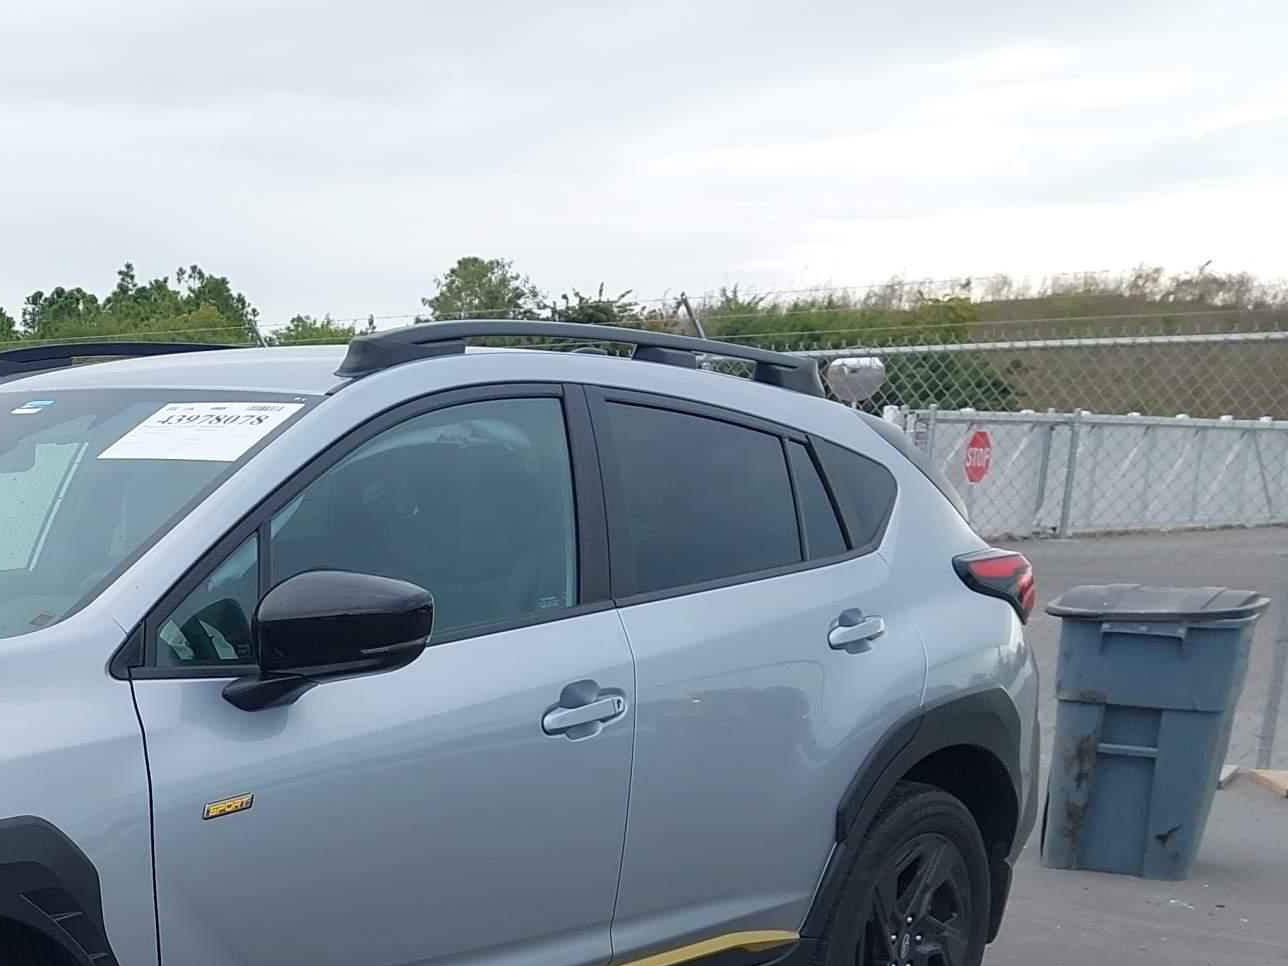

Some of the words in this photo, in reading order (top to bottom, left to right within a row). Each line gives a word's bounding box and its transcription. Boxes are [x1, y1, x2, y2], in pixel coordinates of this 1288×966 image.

[157, 413, 269, 426] 43978078
[966, 447, 990, 467] STOP
[208, 796, 250, 816] SPORT
